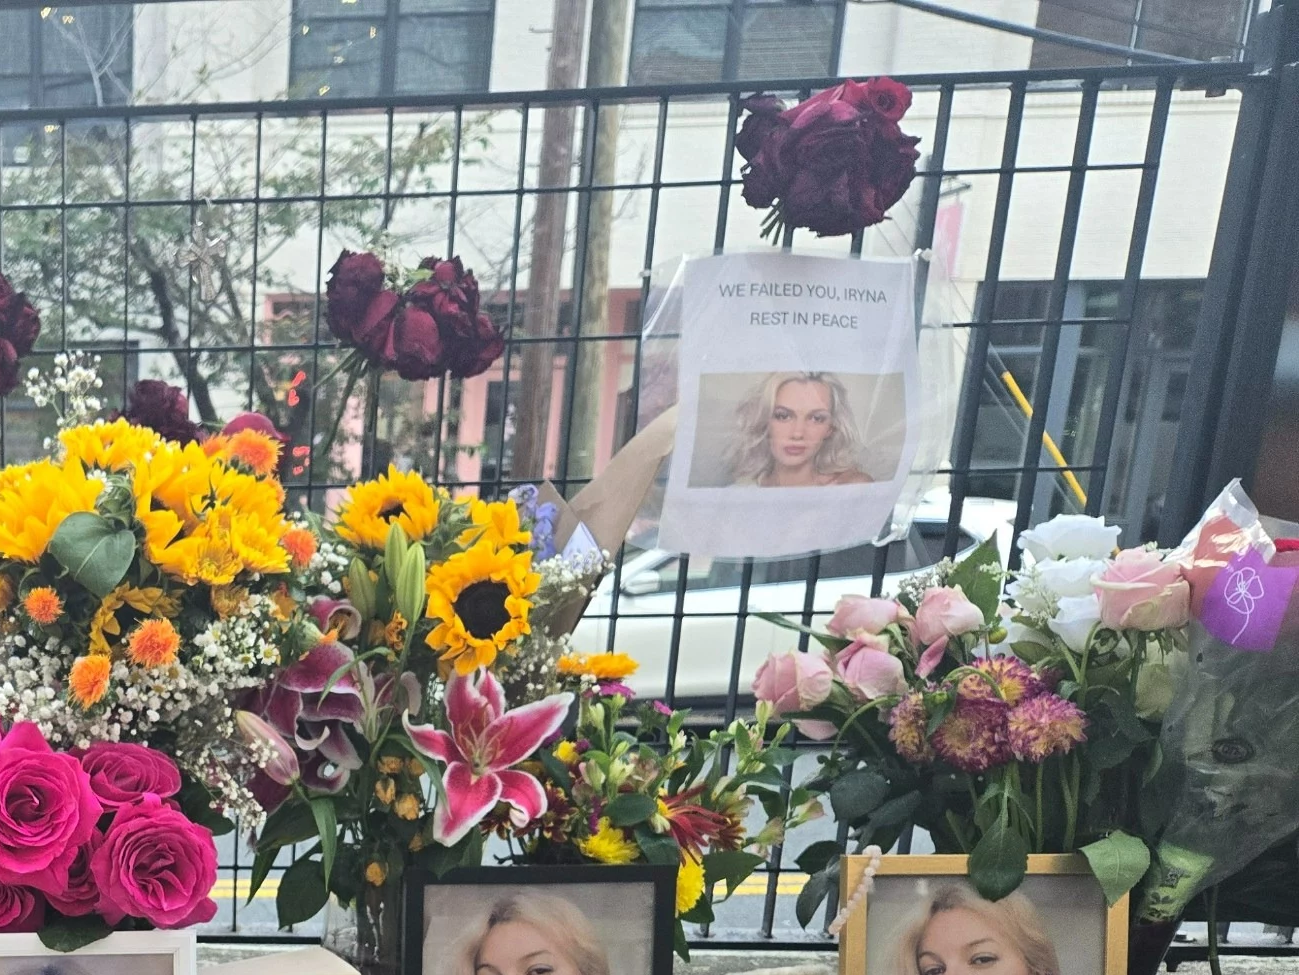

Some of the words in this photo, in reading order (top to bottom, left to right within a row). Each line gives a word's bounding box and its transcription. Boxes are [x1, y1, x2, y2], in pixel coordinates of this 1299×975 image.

[718, 283, 747, 297] WE
[750, 282, 803, 297] FAILED
[806, 285, 841, 301] YOU,
[844, 287, 888, 303] IRYNA
[750, 311, 790, 325] REST
[792, 311, 809, 325] IN
[812, 313, 859, 329] PEACE
